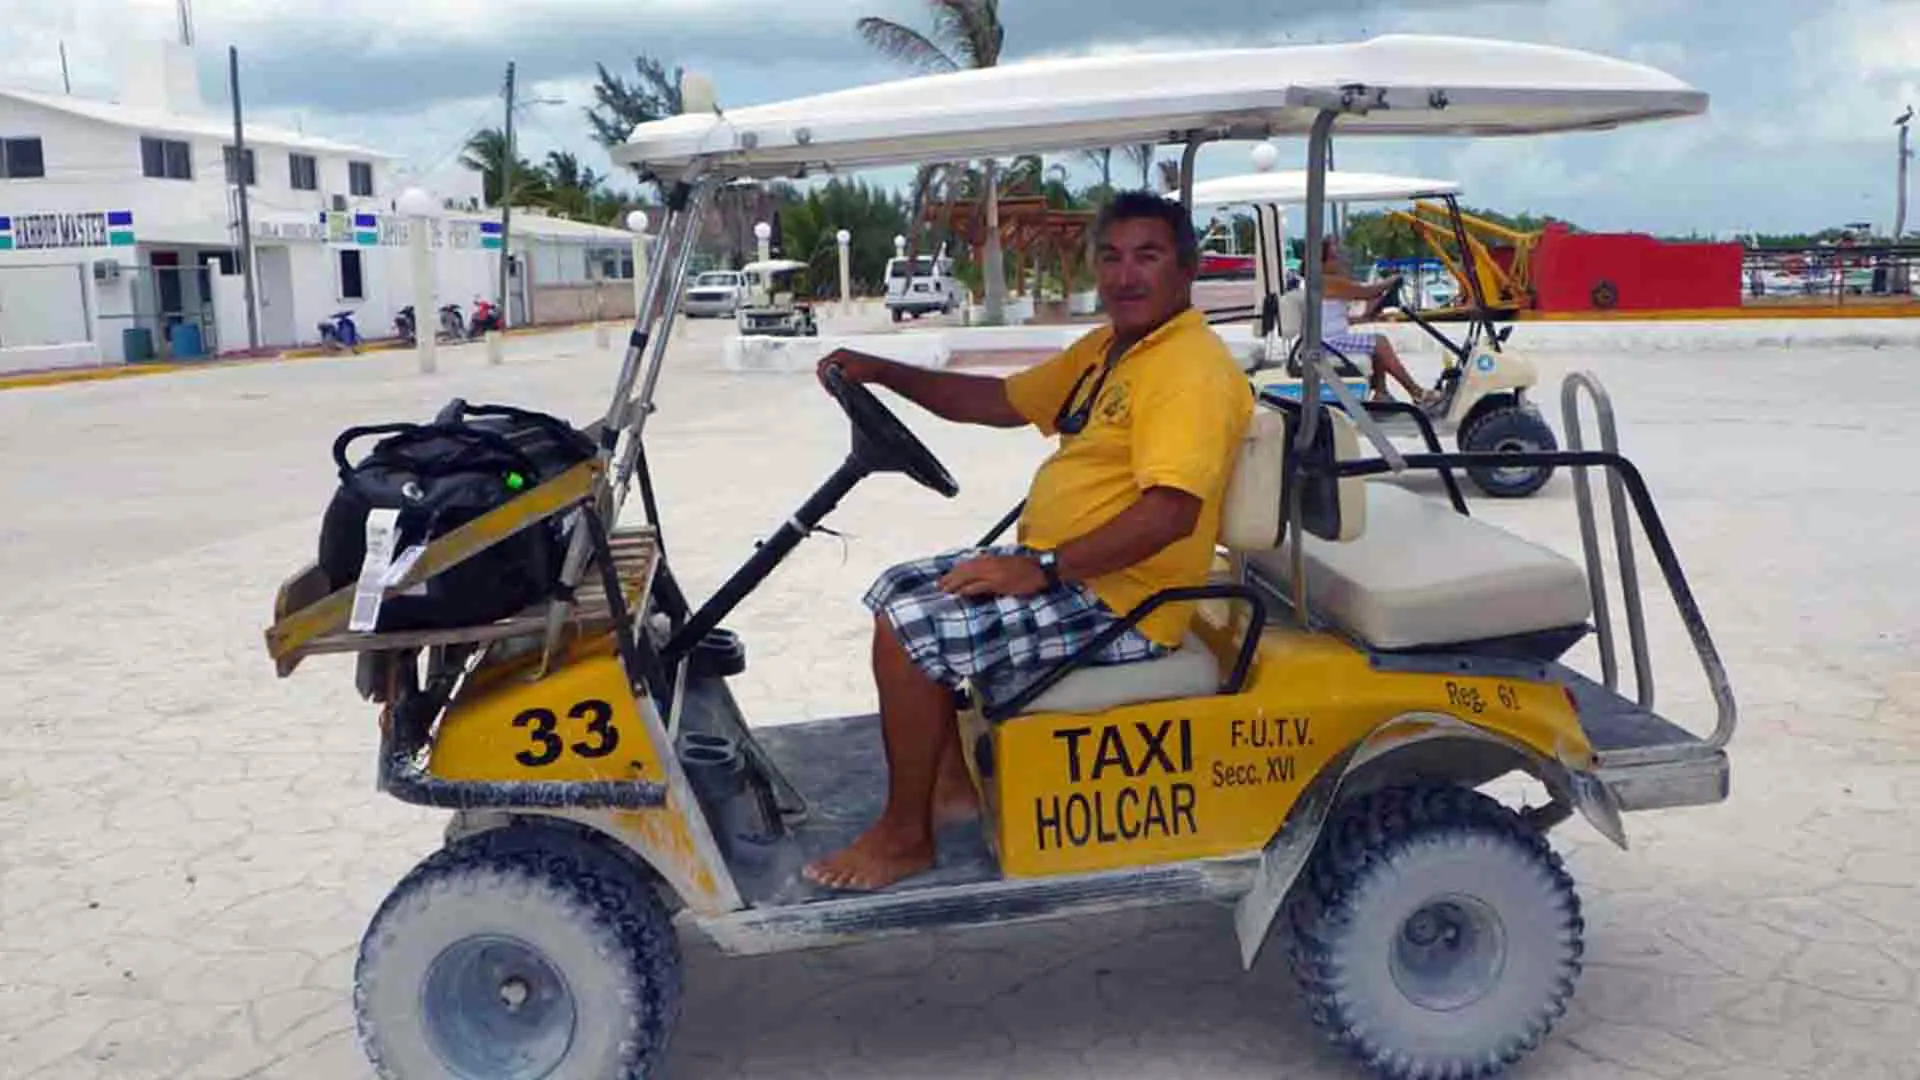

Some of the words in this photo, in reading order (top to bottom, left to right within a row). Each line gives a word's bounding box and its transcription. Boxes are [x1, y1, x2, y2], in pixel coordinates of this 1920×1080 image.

[58, 212, 107, 247] MASTER
[1497, 684, 1521, 710] 61
[511, 699, 620, 767] 33
[1231, 717, 1314, 748] F.U.T.V.
[1053, 719, 1193, 784] TAXI
[1212, 759, 1262, 788] Secc.
[1266, 755, 1295, 783] XVI
[1035, 783, 1197, 850] HOLCAR
